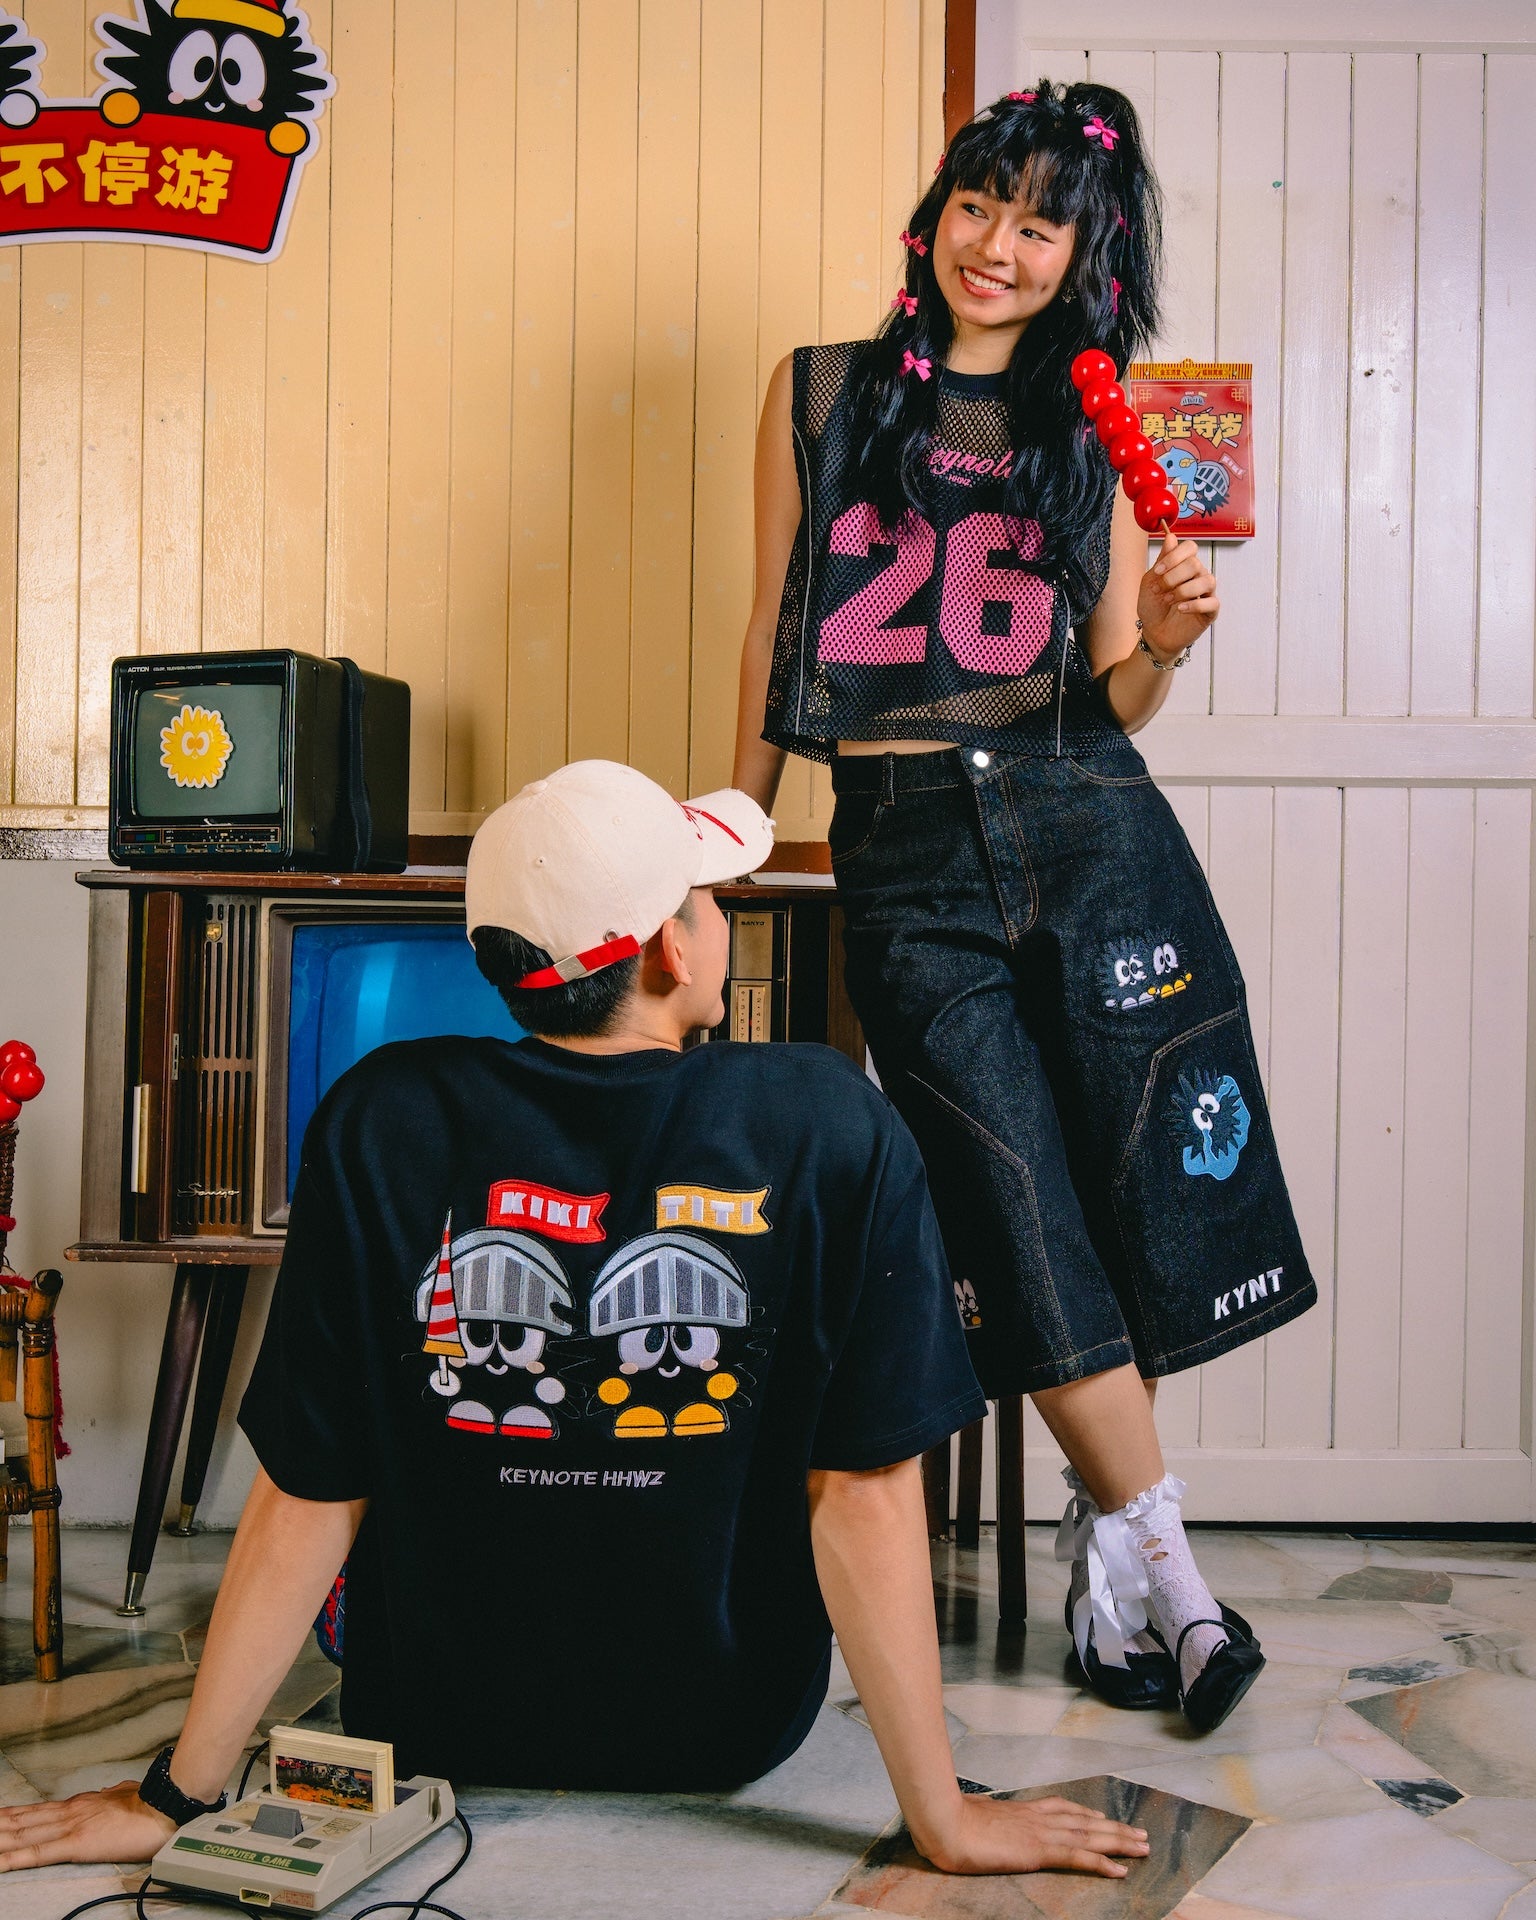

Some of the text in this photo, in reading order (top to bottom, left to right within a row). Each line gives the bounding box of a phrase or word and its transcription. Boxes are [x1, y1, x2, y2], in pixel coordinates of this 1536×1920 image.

[0, 140, 233, 214] 不停游
[1141, 412, 1243, 448] 勇士守岁
[923, 435, 1014, 478] eynot
[817, 502, 1054, 676] 26
[500, 1191, 591, 1229] KIKI
[660, 1195, 754, 1227] TITI
[1214, 1266, 1284, 1321] KYNT
[500, 1466, 666, 1488] KEYNOTE HHWZ
[203, 1844, 293, 1867] COMPUTER GAME
